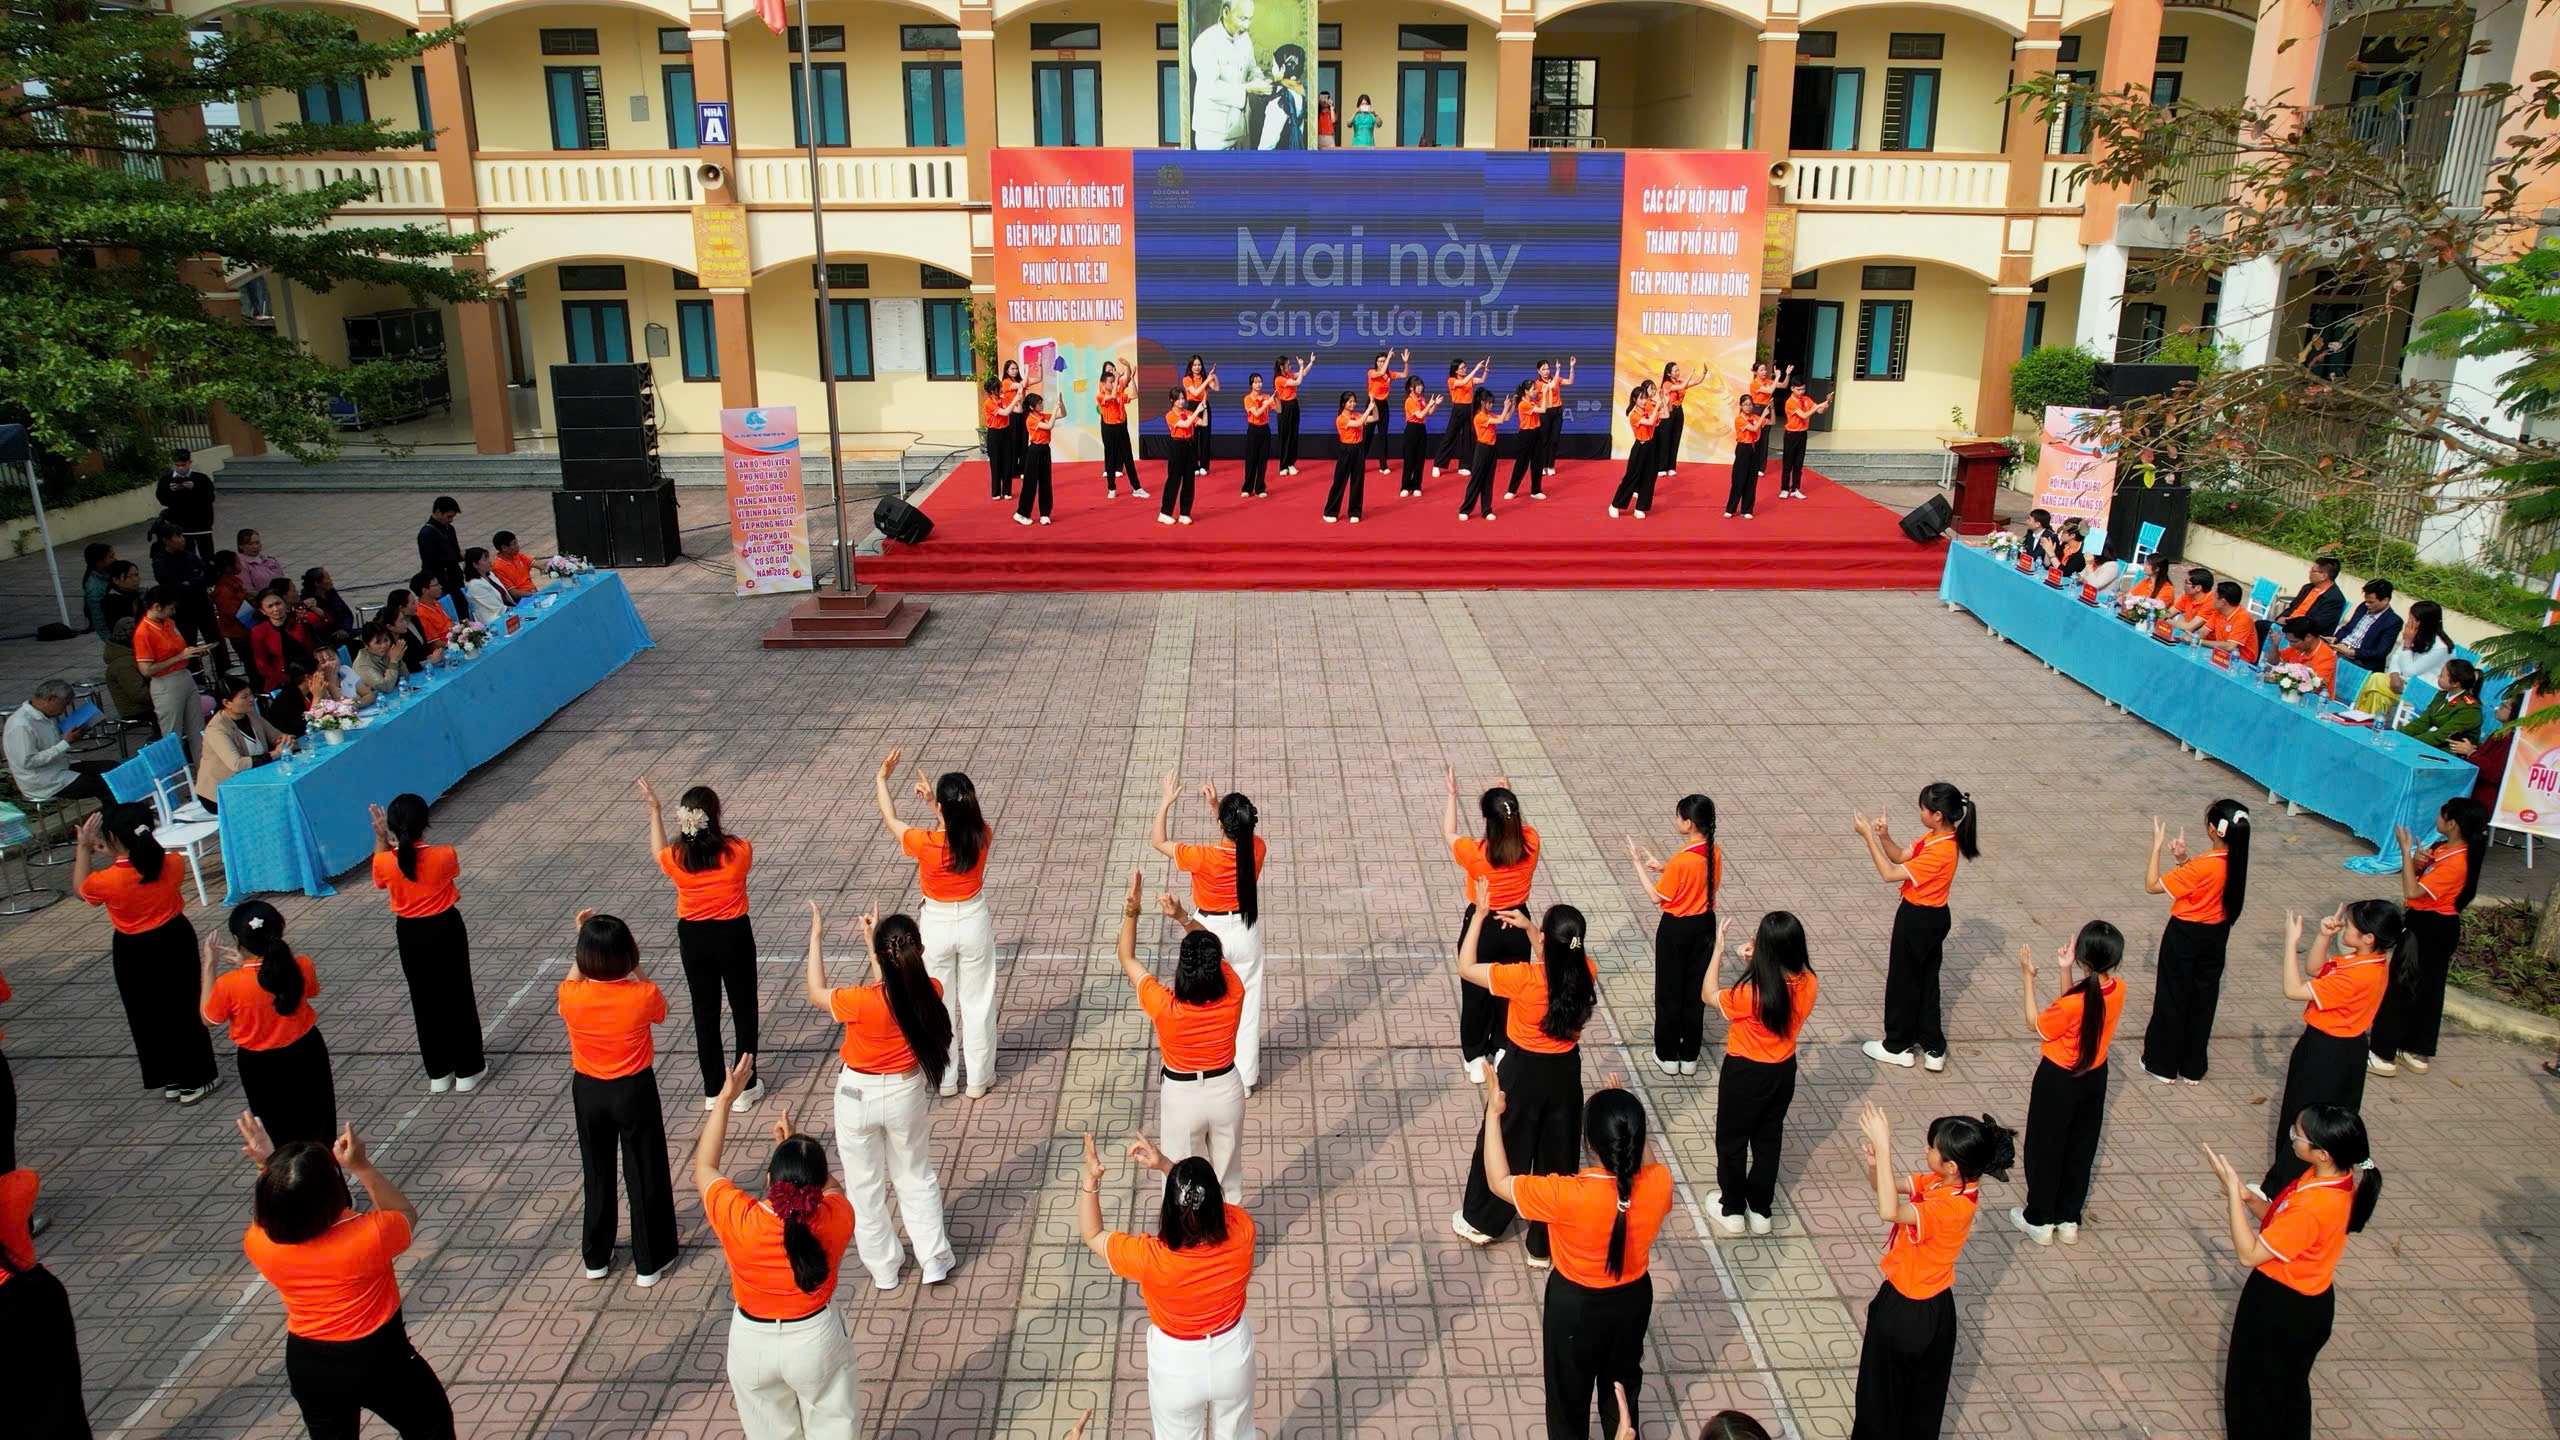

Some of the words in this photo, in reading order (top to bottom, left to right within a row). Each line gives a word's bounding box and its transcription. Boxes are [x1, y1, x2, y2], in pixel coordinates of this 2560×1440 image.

[703, 106, 723, 117] NHÀ
[705, 118, 726, 142] A
[1002, 178, 1021, 208] BẢO
[1023, 181, 1045, 214] MẬT
[1080, 181, 1110, 208] RIÊNG
[1111, 184, 1125, 208] TƯ
[1643, 184, 1664, 213] CÁC
[1665, 182, 1686, 214] CẤP
[1688, 185, 1706, 219] HỘI
[1708, 189, 1729, 218] PHỤ
[1731, 184, 1748, 214] NỮ
[1006, 220, 1029, 252] BIỆN
[1031, 220, 1058, 246] PHÁP
[1060, 225, 1073, 246] AN
[1075, 220, 1100, 246] TOÀN
[1102, 224, 1121, 246] CHO
[1646, 226, 1679, 254] THÀNH
[1680, 222, 1704, 255] PHỐ
[1704, 227, 1717, 255] HÀ
[1719, 227, 1739, 260] NỘI
[1022, 262, 1041, 289] PHỤ
[1044, 258, 1058, 284] NỮ
[1059, 258, 1072, 284] VÀ
[1073, 255, 1092, 284] TRẺ
[1093, 262, 1108, 284] EM
[1237, 225, 1364, 287] Mai
[1390, 223, 1522, 305] này
[1630, 266, 1652, 295] TIÊN
[1654, 272, 1689, 295] PHONG
[1690, 268, 1720, 296] HÀNH
[1721, 268, 1749, 301] ĐỘNG
[1008, 296, 1033, 323] TRÊN
[1035, 295, 1068, 322] KHÔNG
[1070, 299, 1094, 321] GIAN
[1095, 298, 1124, 326] MẠNG
[1238, 299, 1341, 347] sáng
[1353, 303, 1422, 346] tựa
[1437, 300, 1520, 337] như
[1642, 307, 1652, 335] VÌ
[1654, 307, 1678, 335] BÌNH
[1680, 302, 1707, 336] ĐẲNG
[1710, 309, 1732, 337] GIỚI
[774, 568, 789, 576] 2025
[2527, 767, 2559, 797] PHỤ
